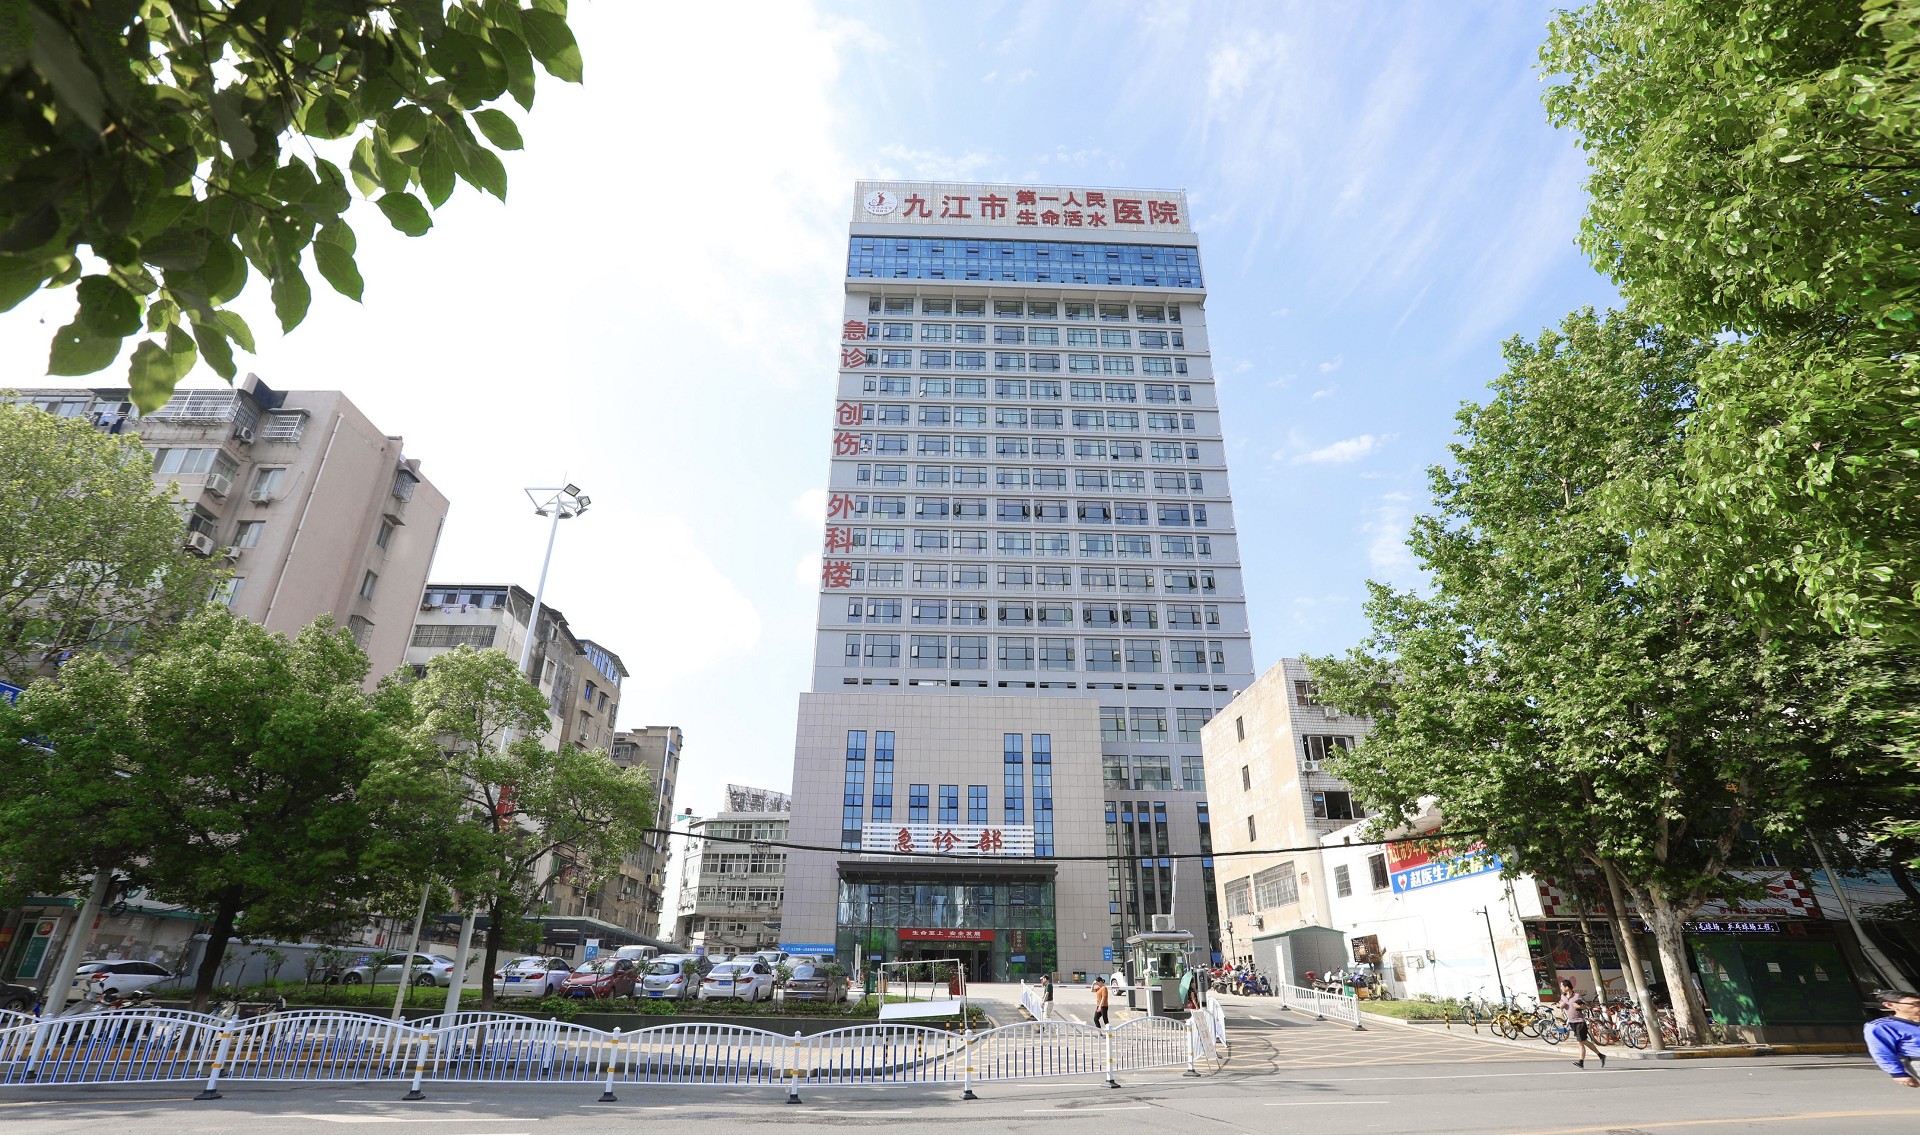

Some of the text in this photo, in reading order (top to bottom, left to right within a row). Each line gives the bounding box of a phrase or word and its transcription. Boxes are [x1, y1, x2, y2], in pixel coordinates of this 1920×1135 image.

[902, 189, 1180, 225] 九江市 第一人民 医院
[1015, 209, 1108, 227] 生命活水
[822, 319, 867, 589] 急诊 创伤 外科楼
[893, 827, 1003, 855] 急诊部
